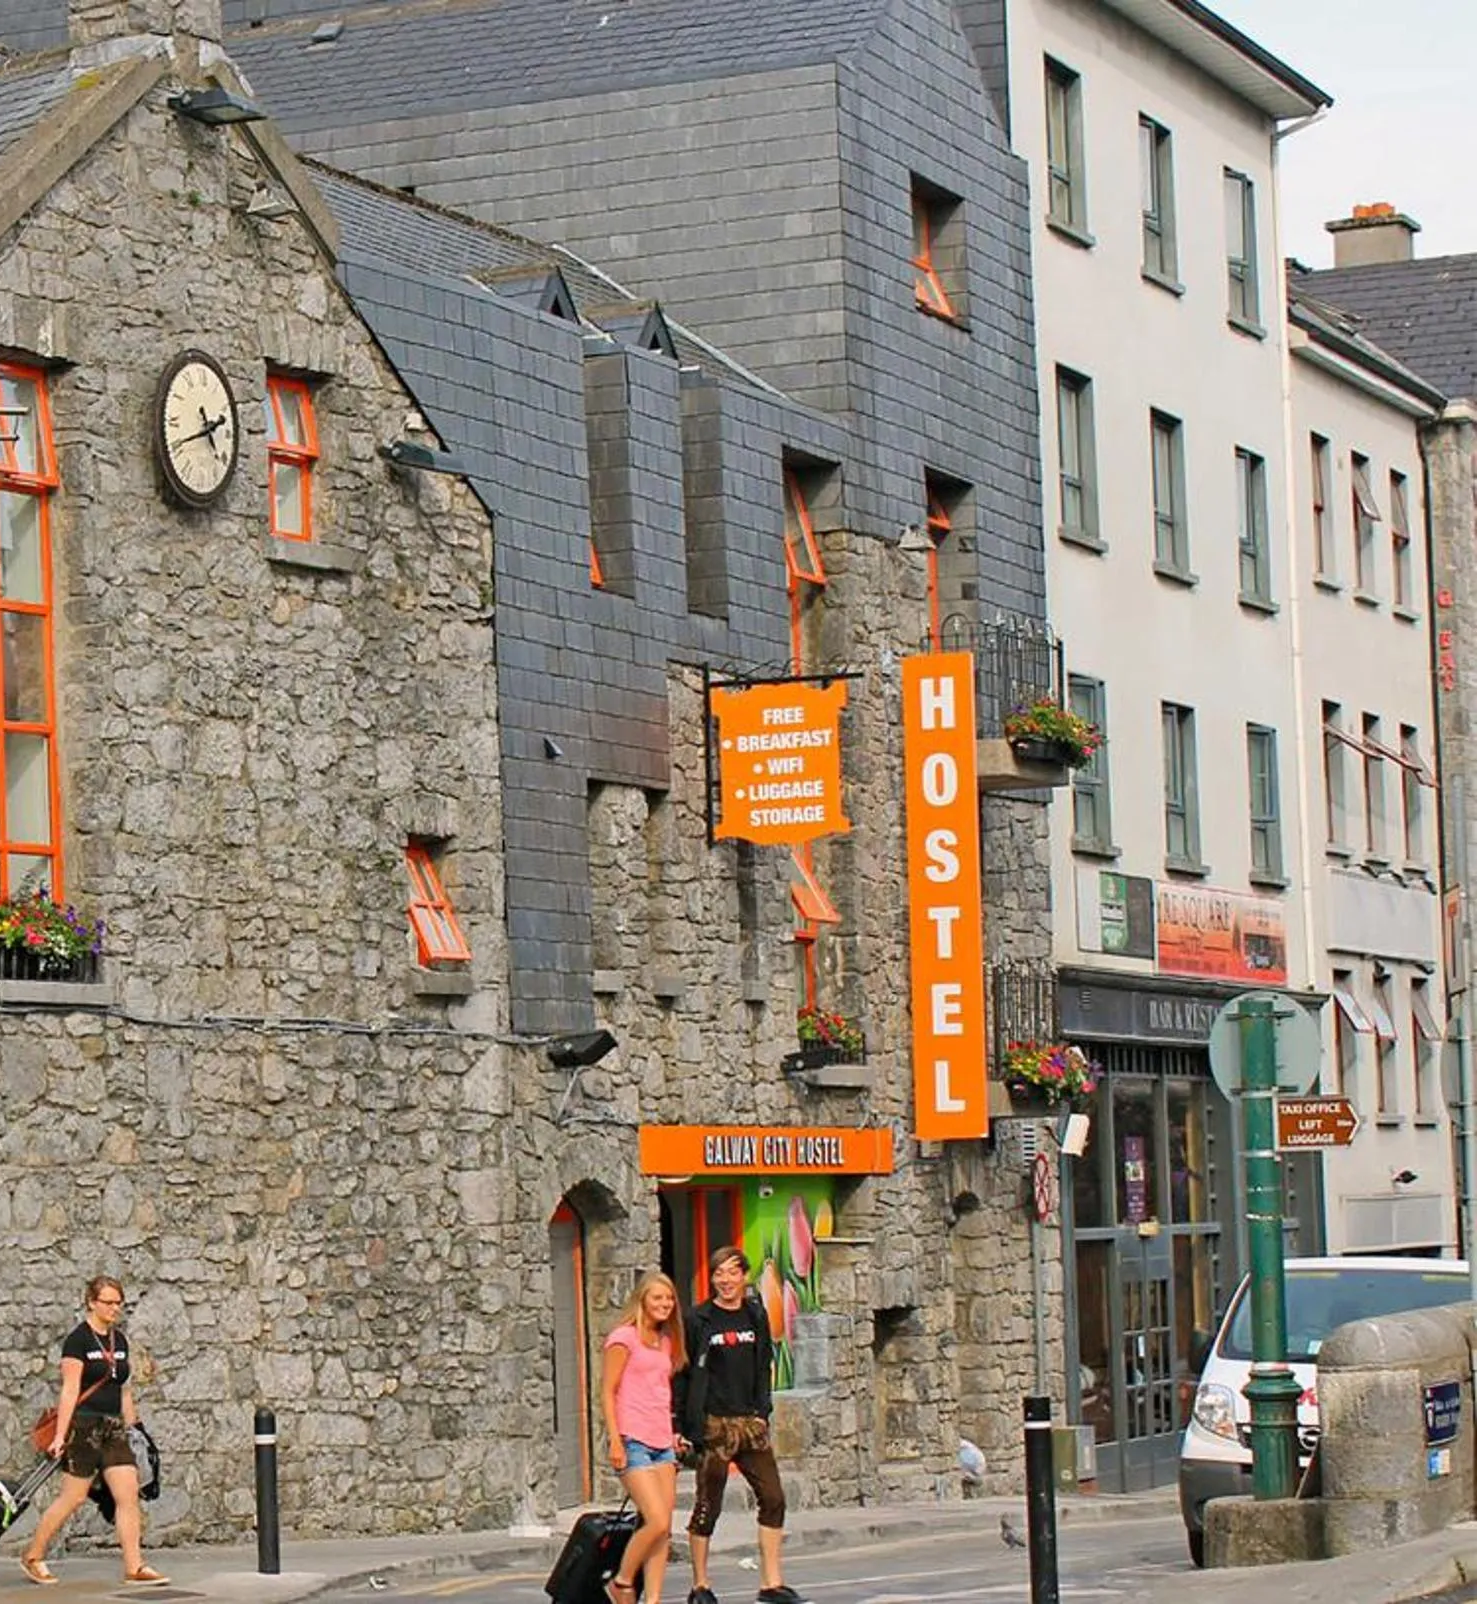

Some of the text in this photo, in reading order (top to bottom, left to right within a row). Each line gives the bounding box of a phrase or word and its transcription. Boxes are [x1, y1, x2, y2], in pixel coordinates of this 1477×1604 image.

[762, 706, 805, 725] FREE
[736, 729, 833, 752] BREAKFAST
[767, 757, 804, 775] WIFI
[748, 780, 824, 801] LUGGAGE
[750, 805, 825, 827] STORAGE
[919, 675, 966, 1114] HOSTEL
[1279, 1102, 1341, 1114] TAXI OFFICE
[1299, 1119, 1323, 1130] LEFT
[1287, 1133, 1335, 1145] LUGGAGE
[704, 1136, 845, 1166] GALWAY CITY HOSTEL
